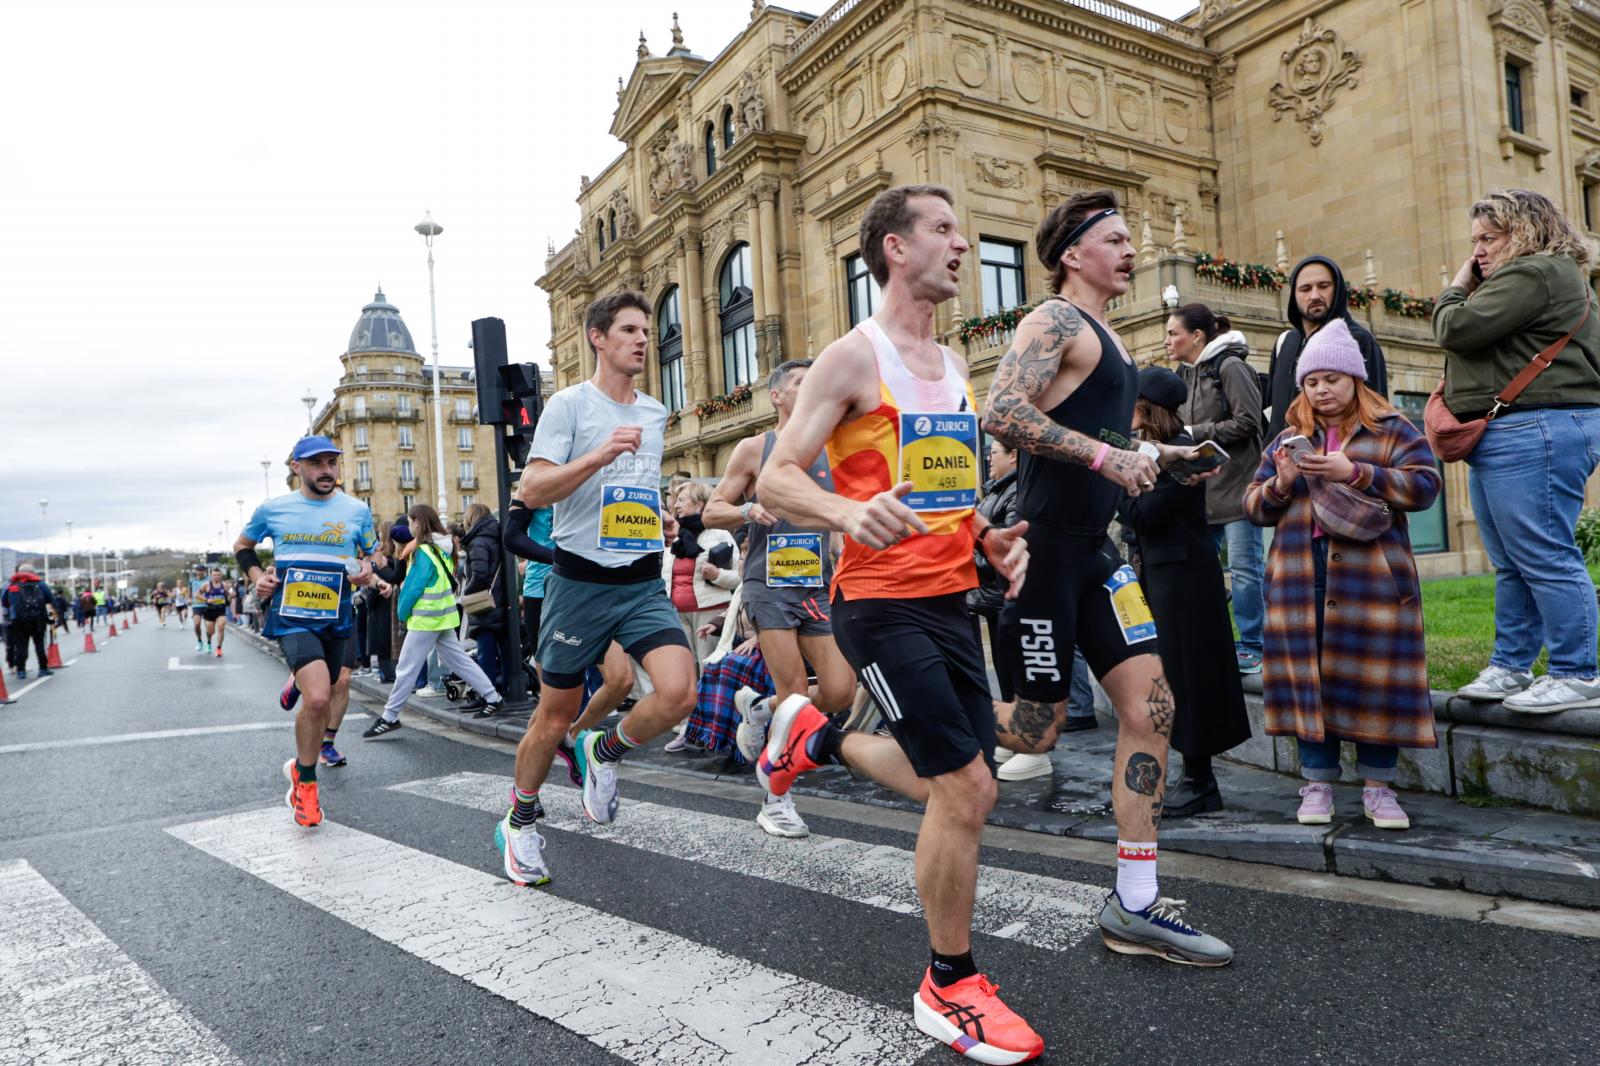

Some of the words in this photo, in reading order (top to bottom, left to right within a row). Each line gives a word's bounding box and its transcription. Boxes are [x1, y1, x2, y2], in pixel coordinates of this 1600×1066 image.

[935, 421, 969, 432] ZURICH
[923, 456, 970, 470] DANIEL
[938, 477, 957, 488] 493
[627, 491, 653, 500] ZURICH
[616, 515, 657, 525] MAXIME
[628, 529, 643, 537] 365
[306, 574, 334, 583] ZURICH
[297, 591, 332, 600] DANIEL
[1020, 618, 1061, 682] PSRC
